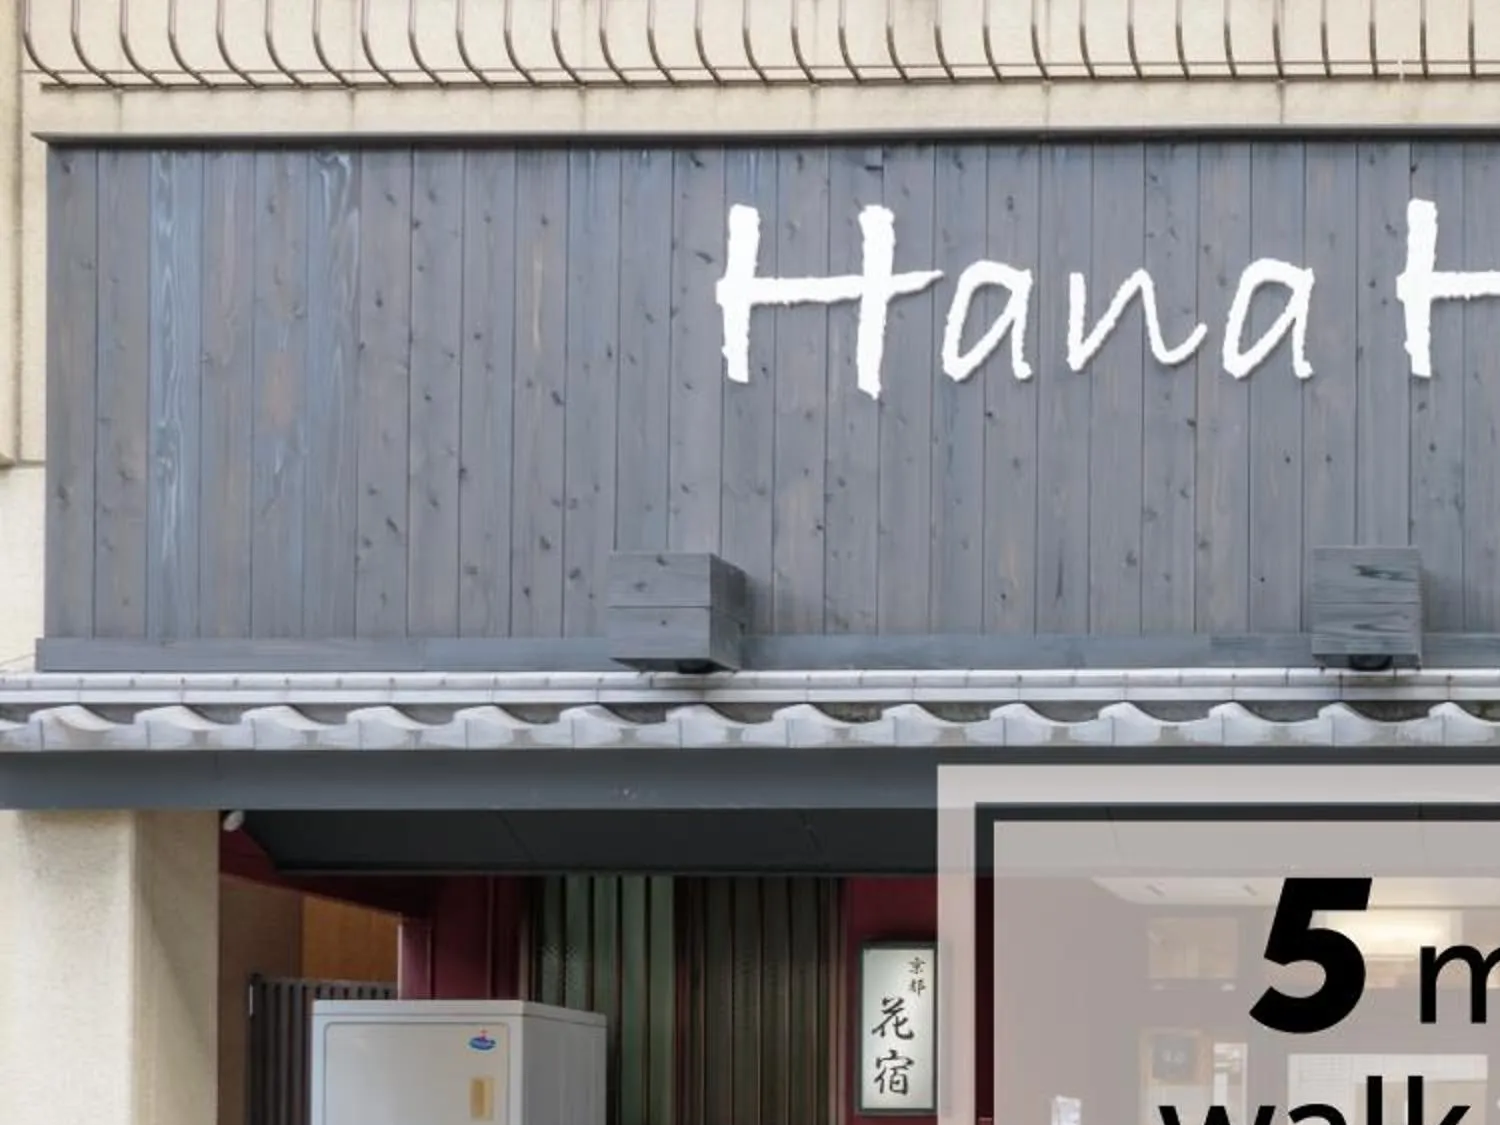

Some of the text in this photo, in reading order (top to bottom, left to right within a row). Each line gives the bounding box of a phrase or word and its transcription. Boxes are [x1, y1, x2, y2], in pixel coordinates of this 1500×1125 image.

[716, 203, 1316, 400] Hana
[908, 957, 926, 995] 京都
[872, 997, 914, 1095] 花宿
